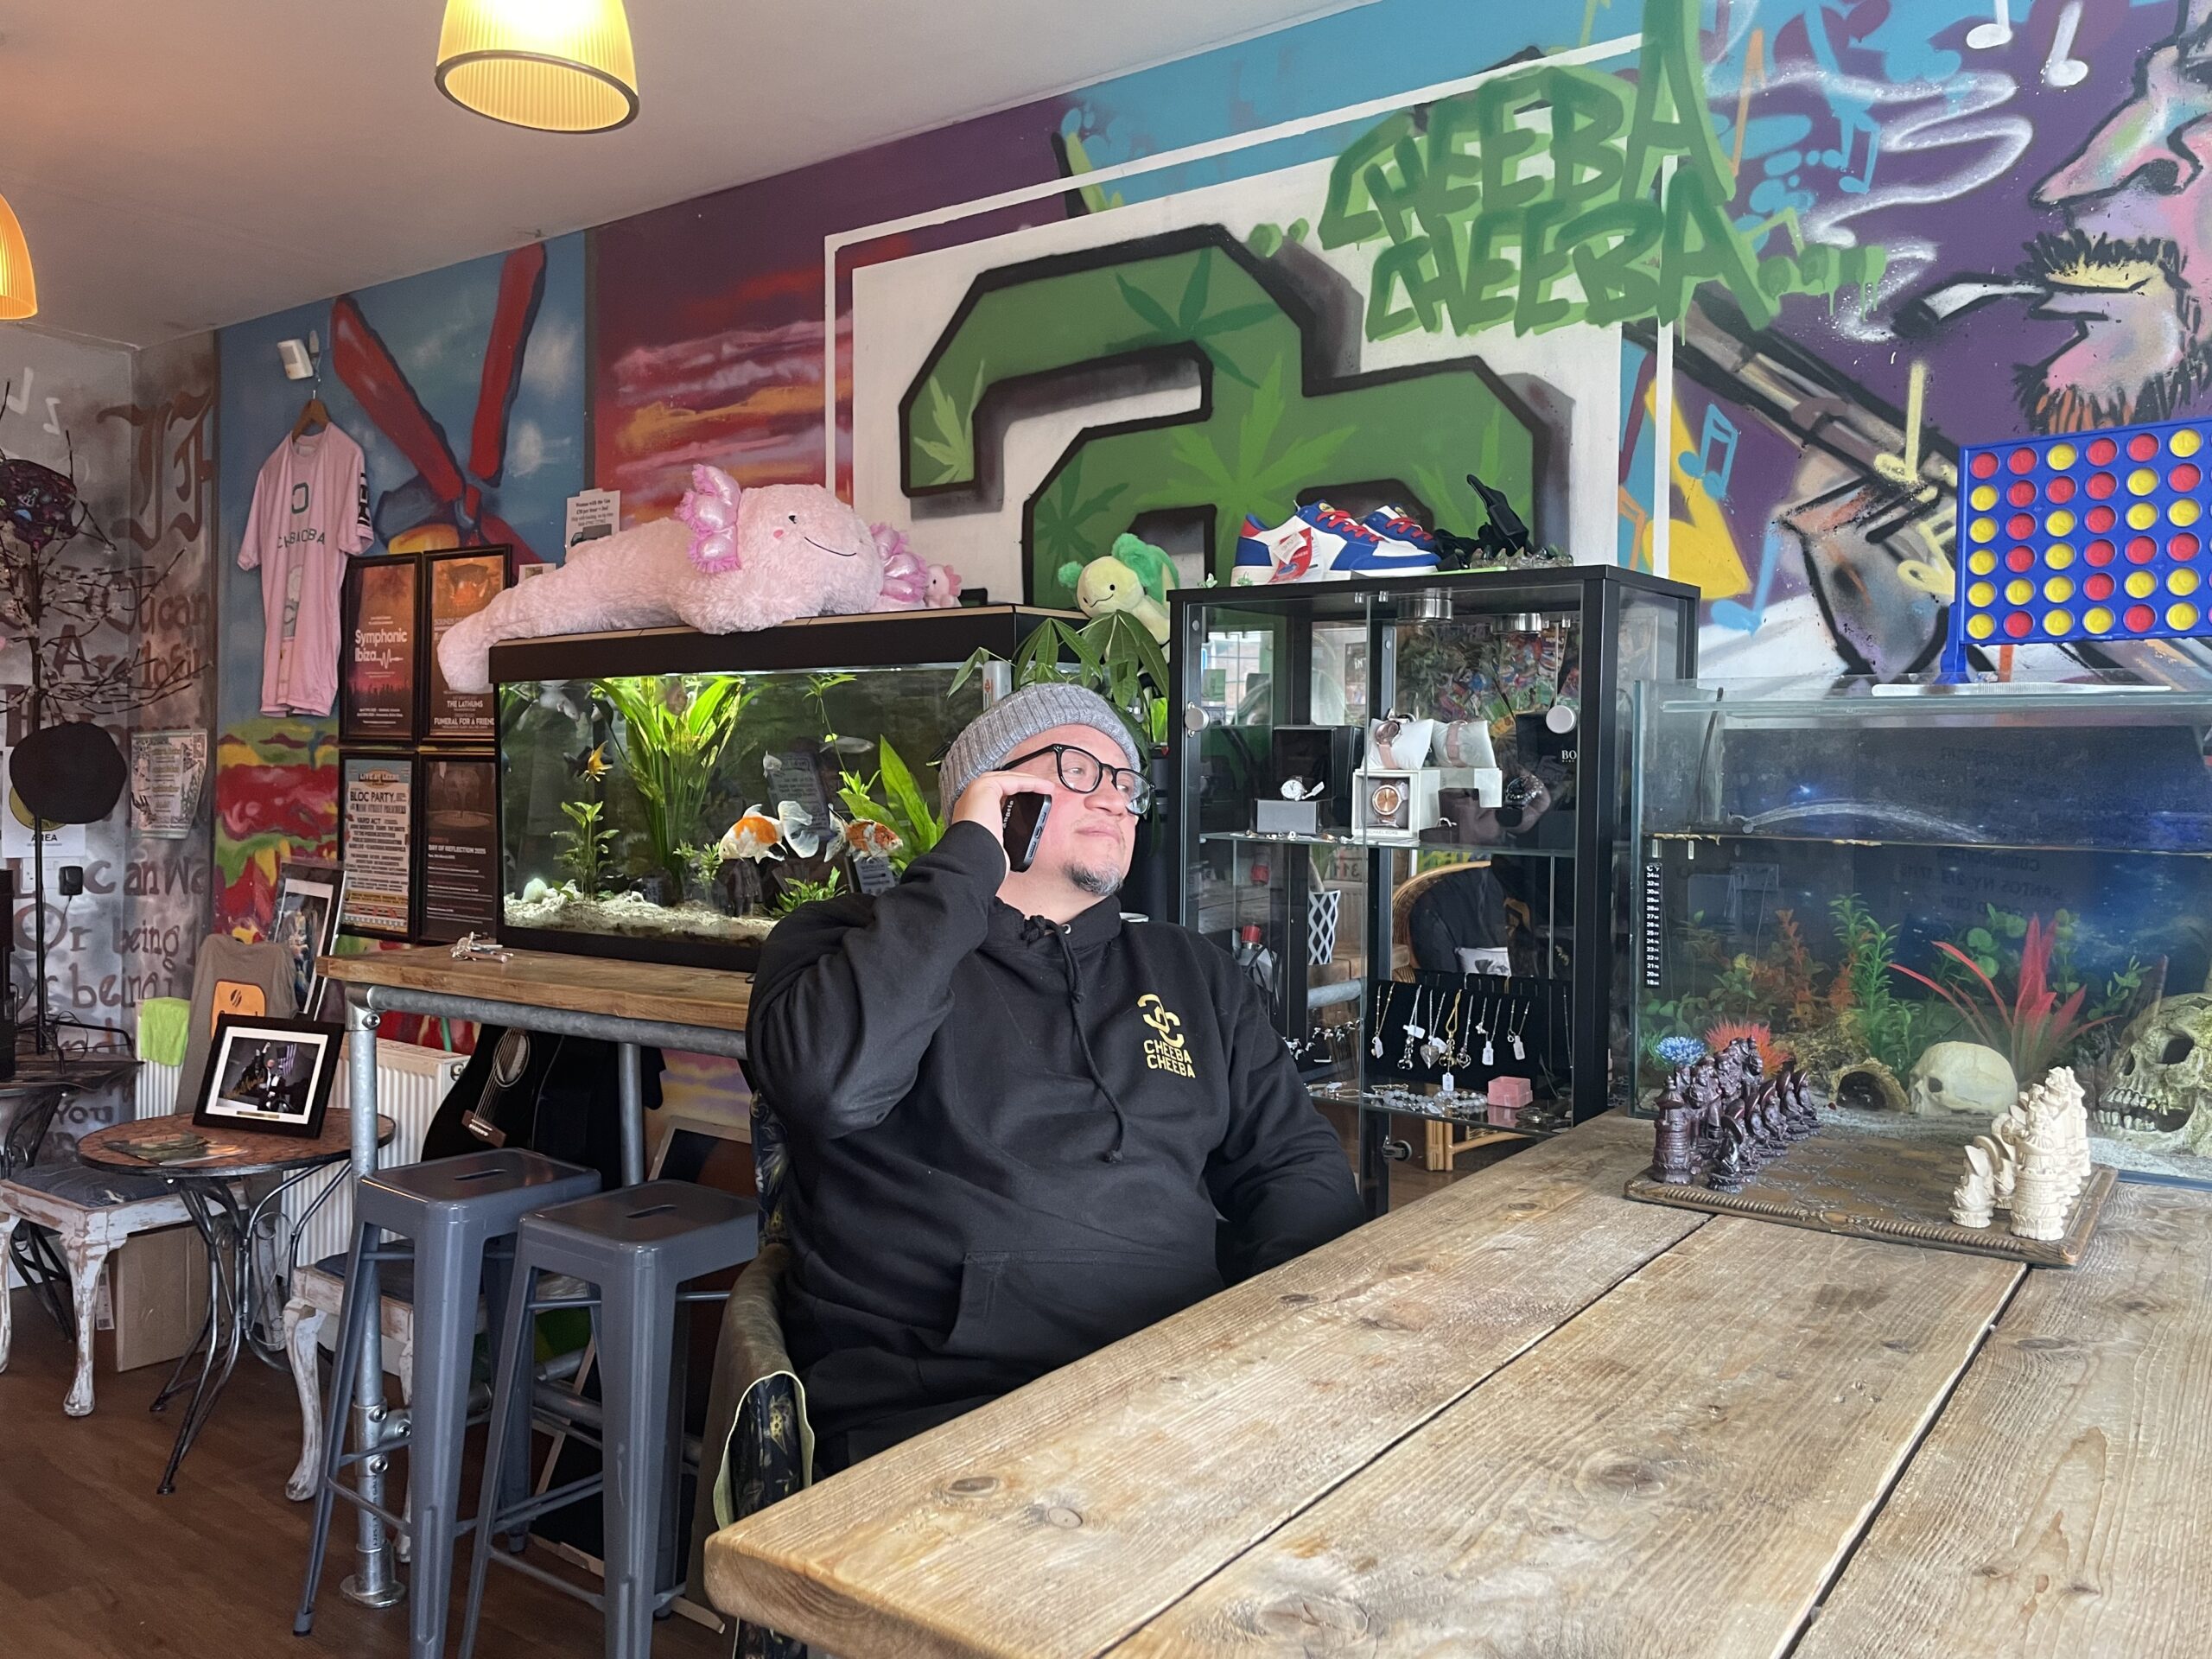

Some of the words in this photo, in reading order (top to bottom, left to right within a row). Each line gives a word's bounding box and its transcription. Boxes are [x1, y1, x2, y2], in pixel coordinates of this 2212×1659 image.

[1319, 0, 1735, 251] CHEEBA
[1365, 165, 1779, 342] CHEEBA
[355, 627, 408, 647] Symphonic
[355, 648, 378, 663] Ibiza
[459, 717, 470, 726] FOR
[350, 791, 369, 802] BLOC
[371, 791, 394, 803] PARTY
[1143, 1039, 1192, 1064] CHEEBA
[1147, 1054, 1196, 1078] CHEEBA
